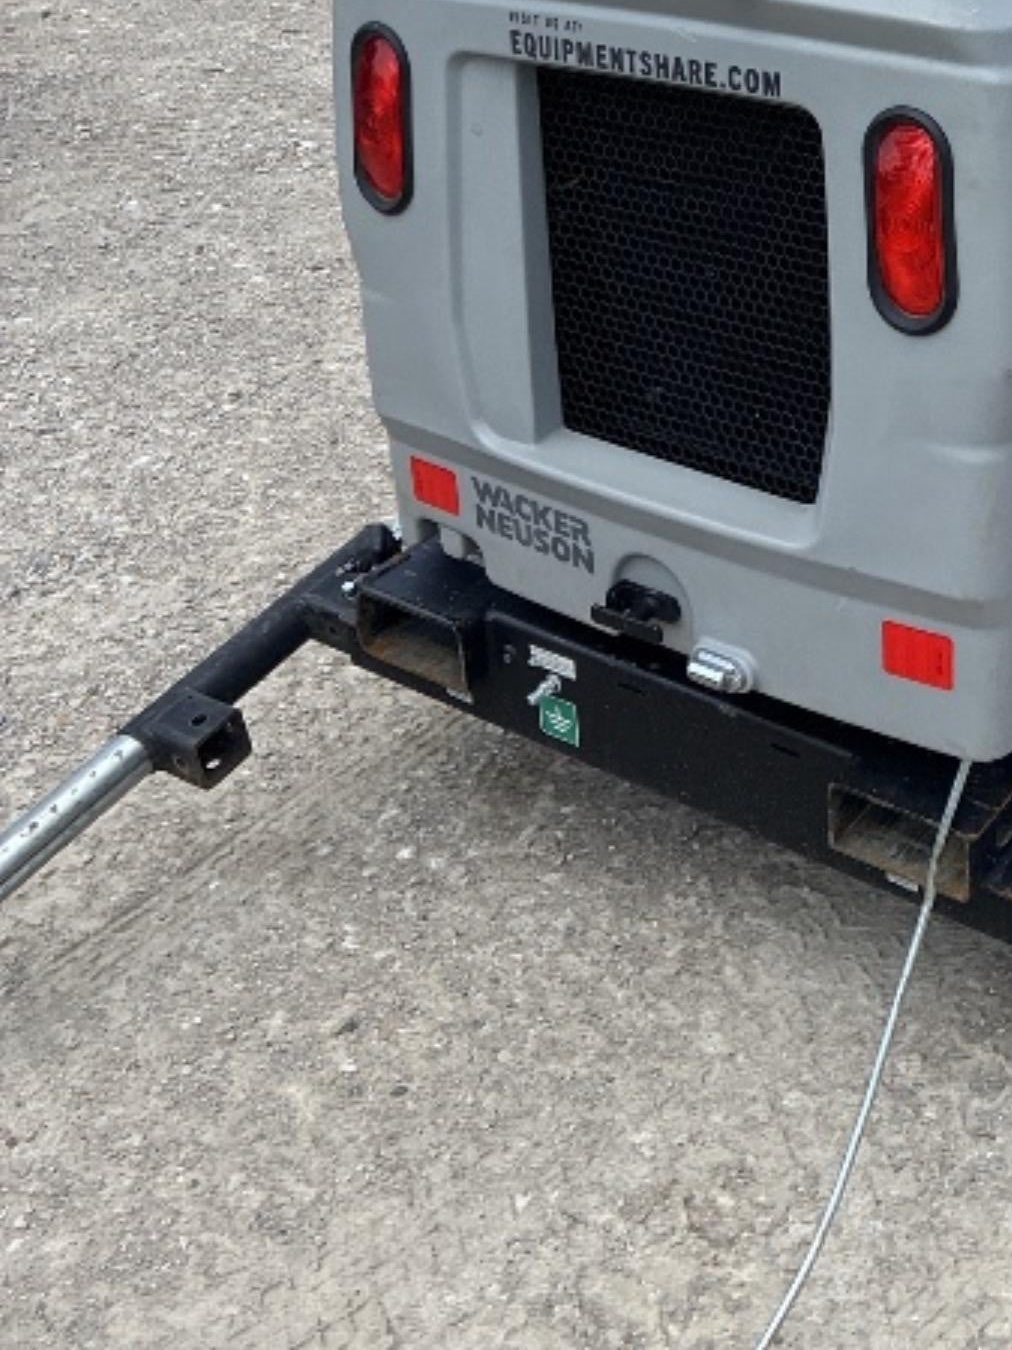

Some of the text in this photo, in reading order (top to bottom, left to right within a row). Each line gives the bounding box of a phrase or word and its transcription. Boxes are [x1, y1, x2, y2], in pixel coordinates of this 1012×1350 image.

[509, 29, 782, 98] EQUIPMENTSHARE.COM
[472, 476, 592, 547] WACKER
[476, 503, 595, 575] NEUSON
